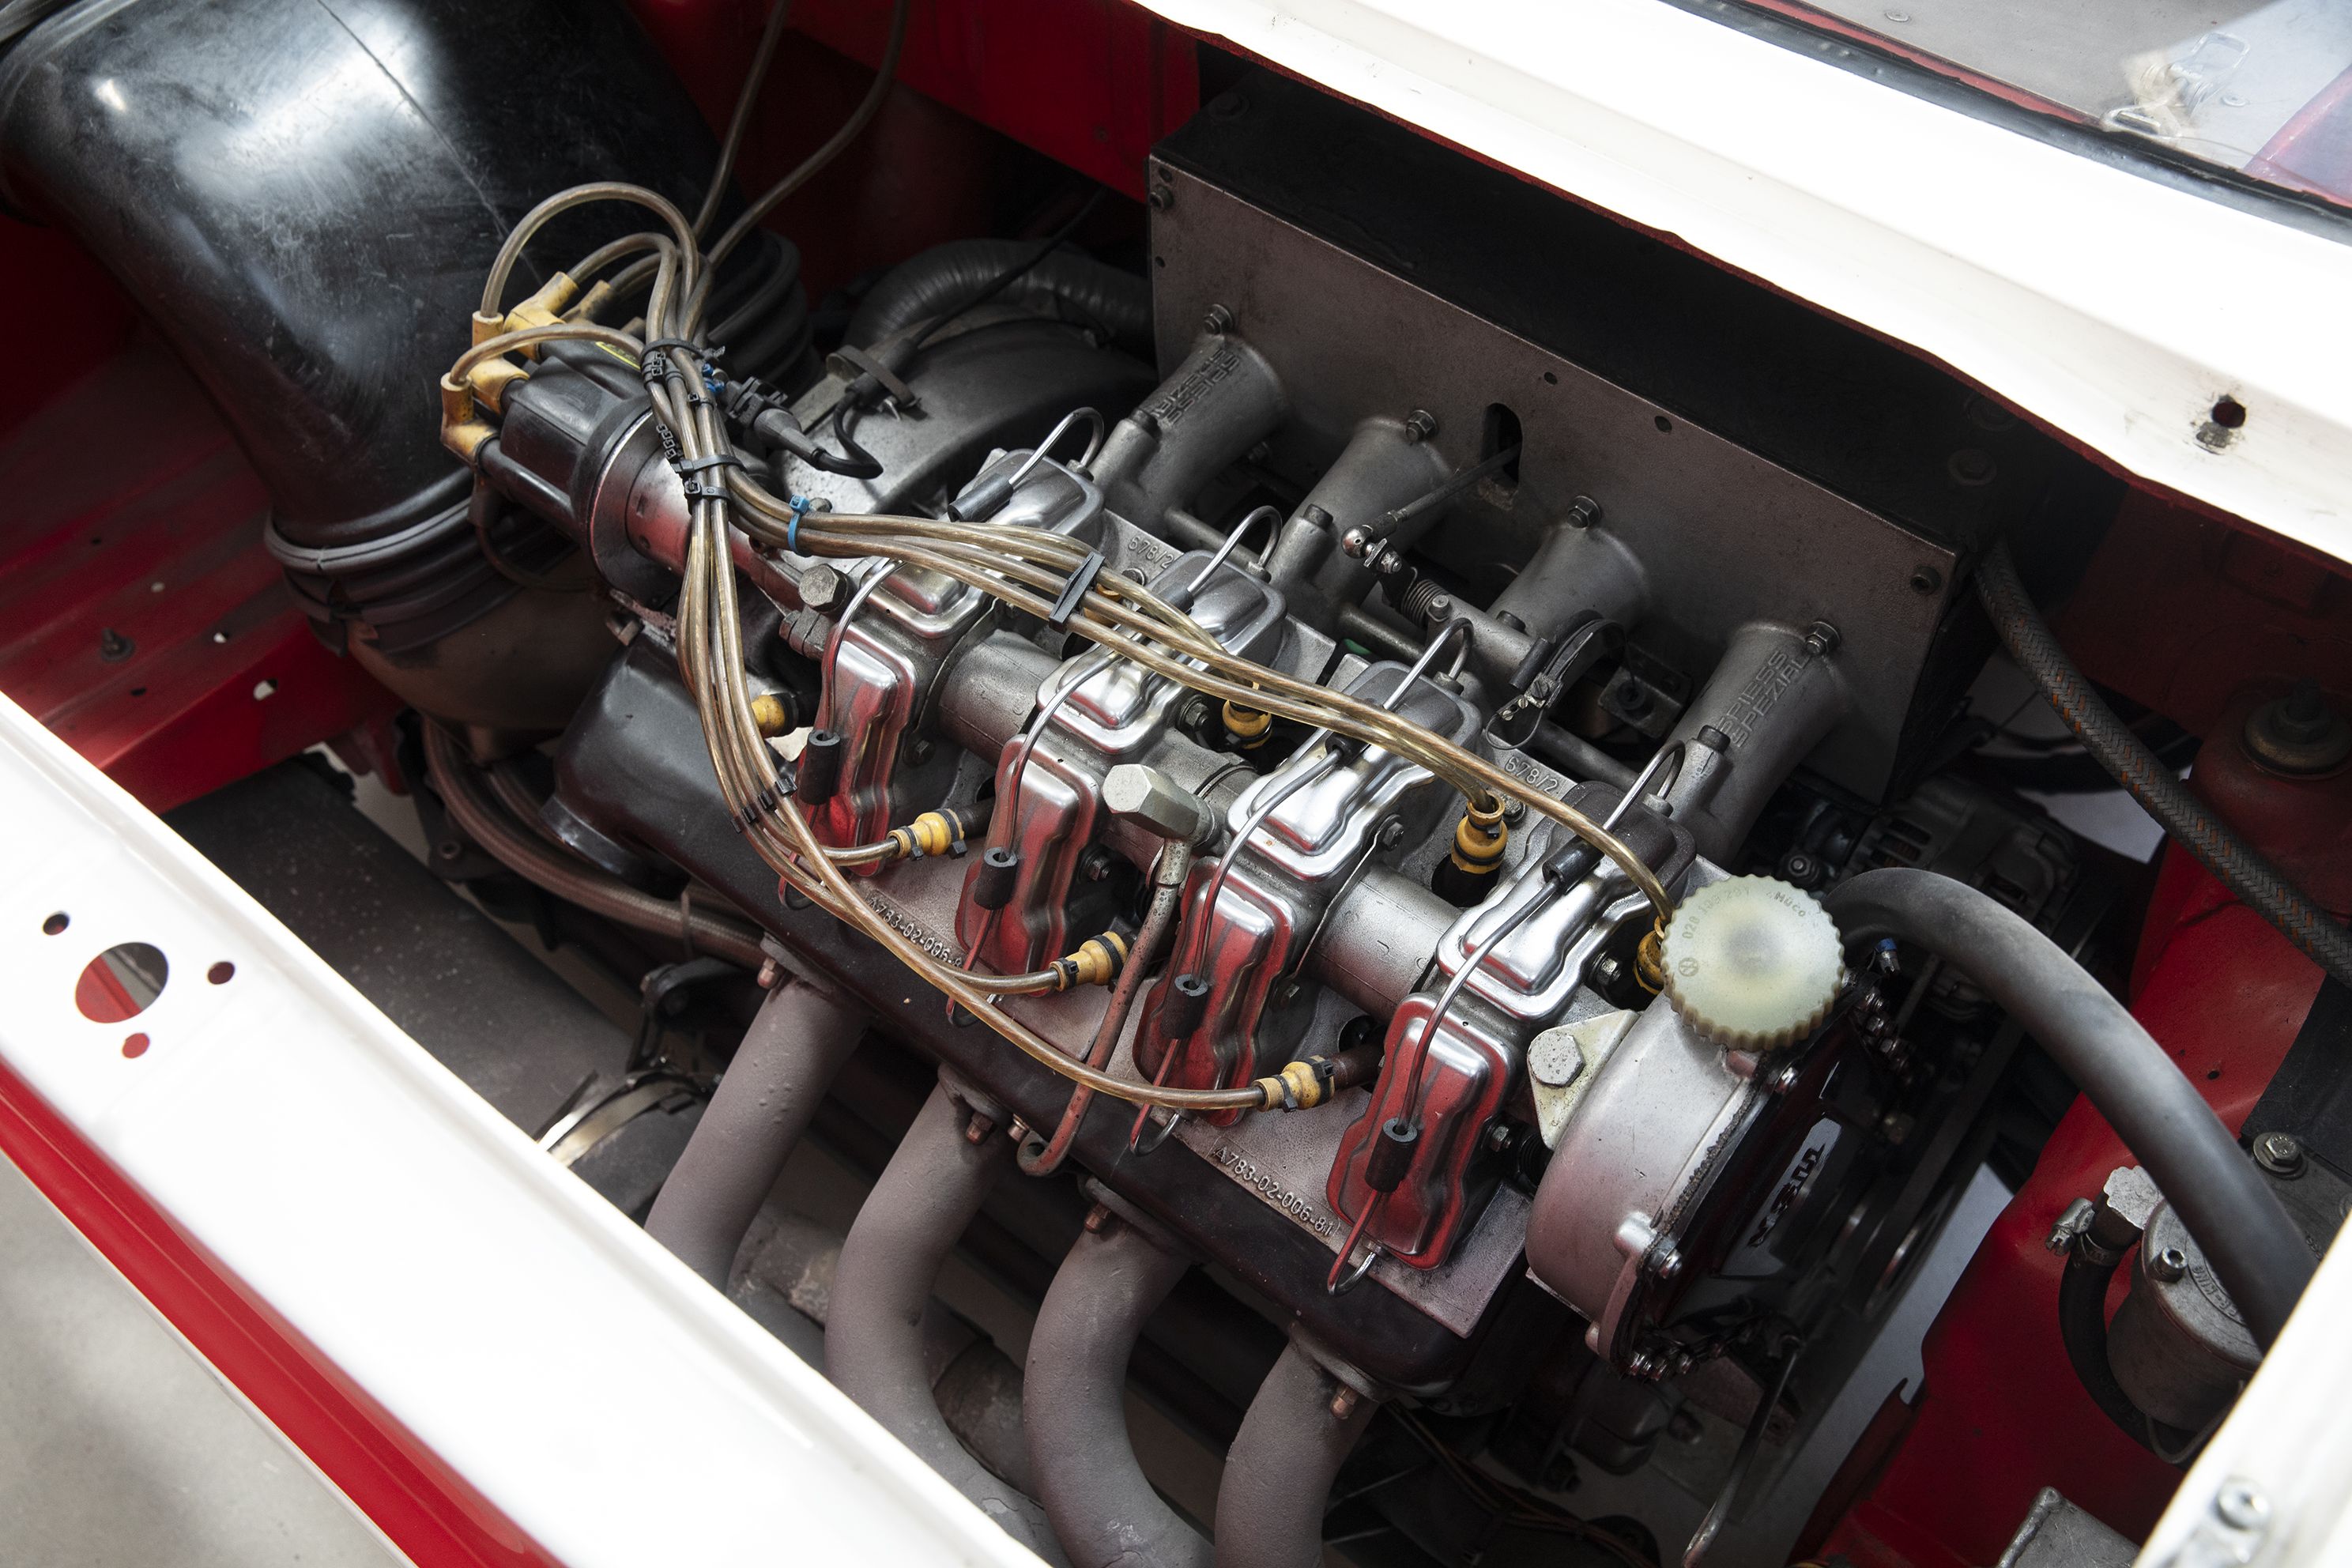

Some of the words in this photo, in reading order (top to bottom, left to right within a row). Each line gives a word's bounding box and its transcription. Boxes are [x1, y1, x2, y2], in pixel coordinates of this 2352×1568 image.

[1165, 354, 1239, 425] SPIESS
[1129, 537, 1174, 569] 678/2
[1716, 650, 1788, 735] SPIESS
[1731, 656, 1811, 748] SPEZIAL
[1506, 756, 1559, 795] 678/2
[1213, 1146, 1334, 1236] A783-02-006-81
